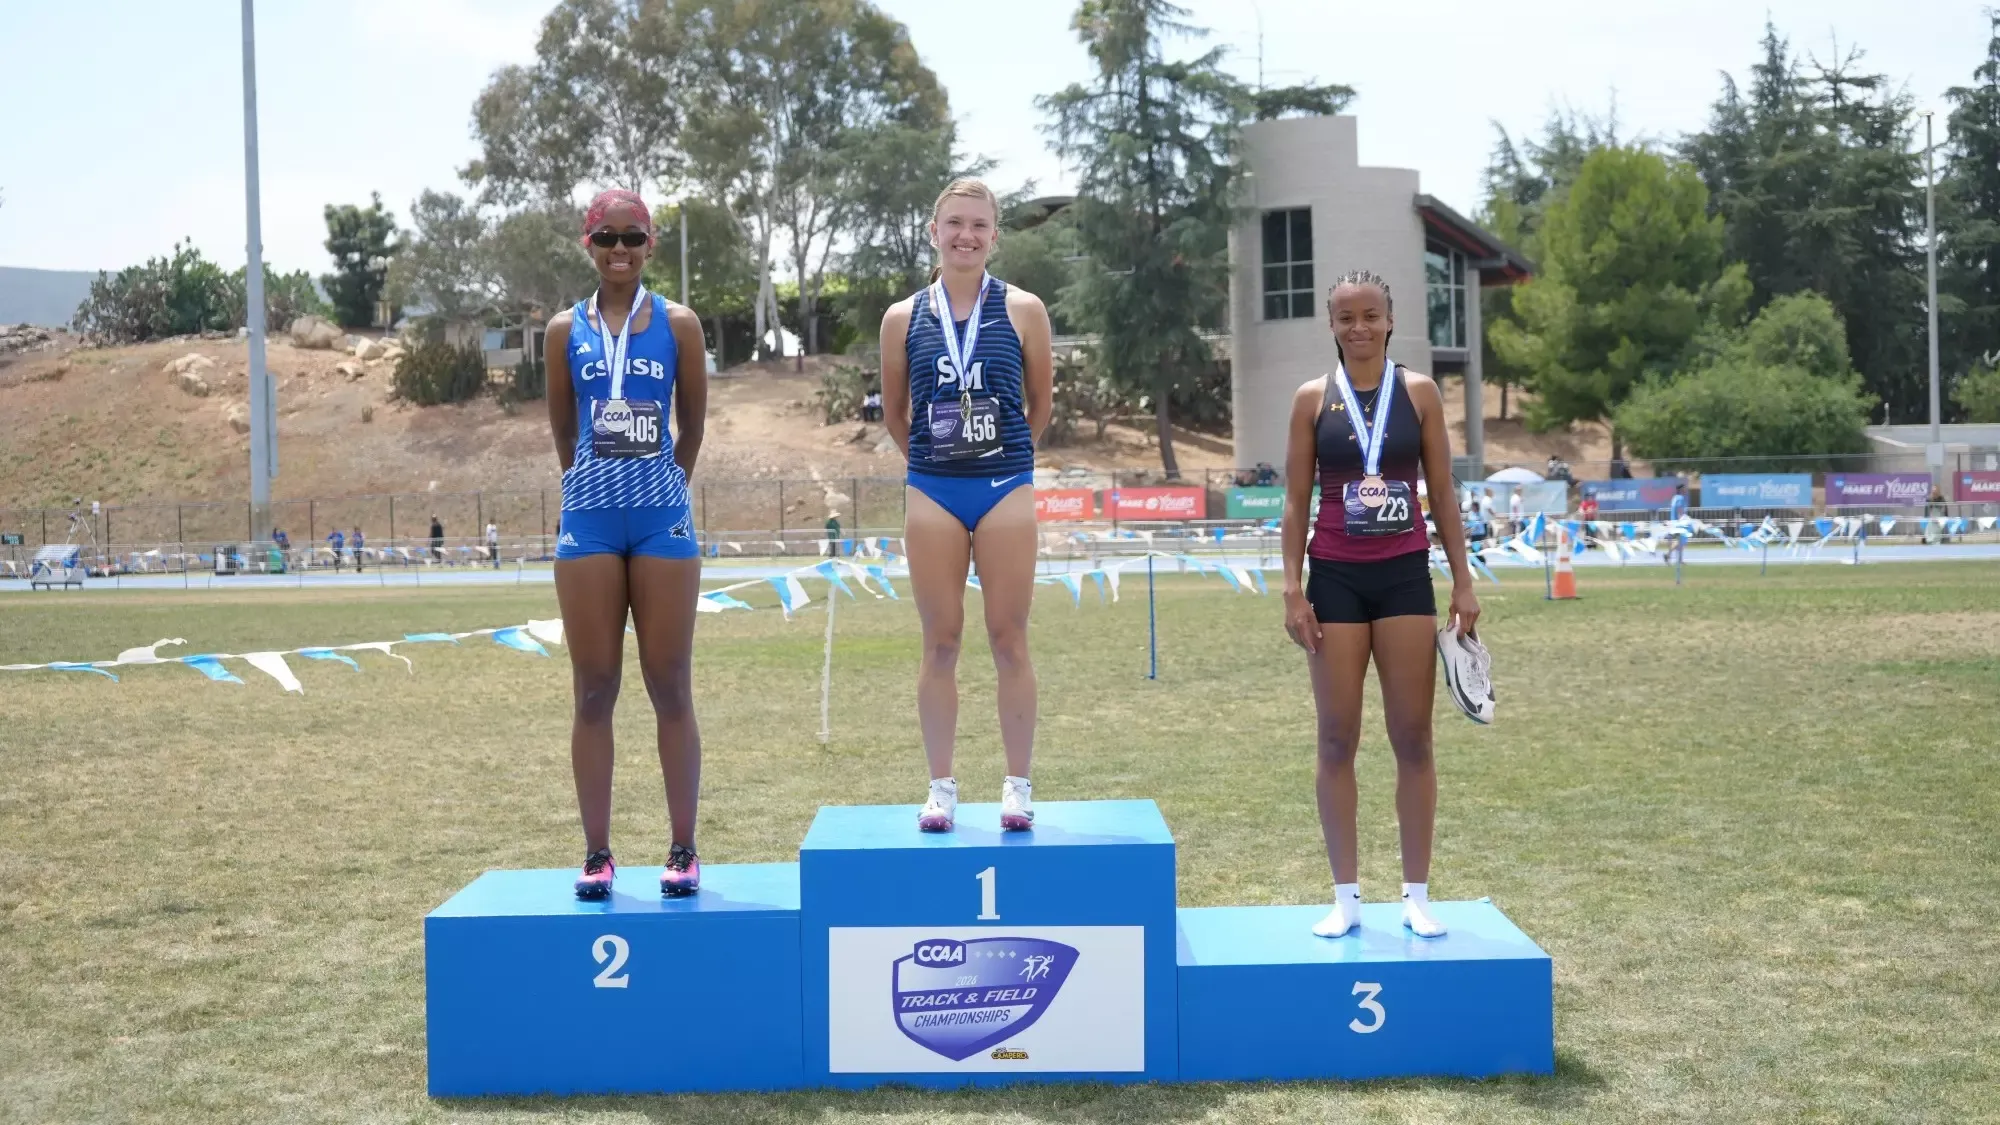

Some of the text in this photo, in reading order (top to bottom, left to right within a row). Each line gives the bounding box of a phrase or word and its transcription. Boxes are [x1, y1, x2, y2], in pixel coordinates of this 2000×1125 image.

[604, 411, 631, 421] CCAA
[624, 415, 658, 443] 405
[962, 413, 997, 443] 456
[1360, 487, 1386, 497] CCAA
[1842, 484, 1872, 495] MAKE
[1874, 484, 1884, 494] IT
[1377, 496, 1409, 521] 223
[975, 866, 1000, 920] 1
[592, 934, 630, 989] 2
[917, 945, 963, 962] CCAA
[955, 975, 977, 986] 2026
[901, 987, 1038, 1009] TRACK & FIELD
[1348, 981, 1386, 1034] 3
[914, 1009, 1011, 1028] CHAMPIONSHIPS
[991, 1051, 1028, 1060] CAMPERO
